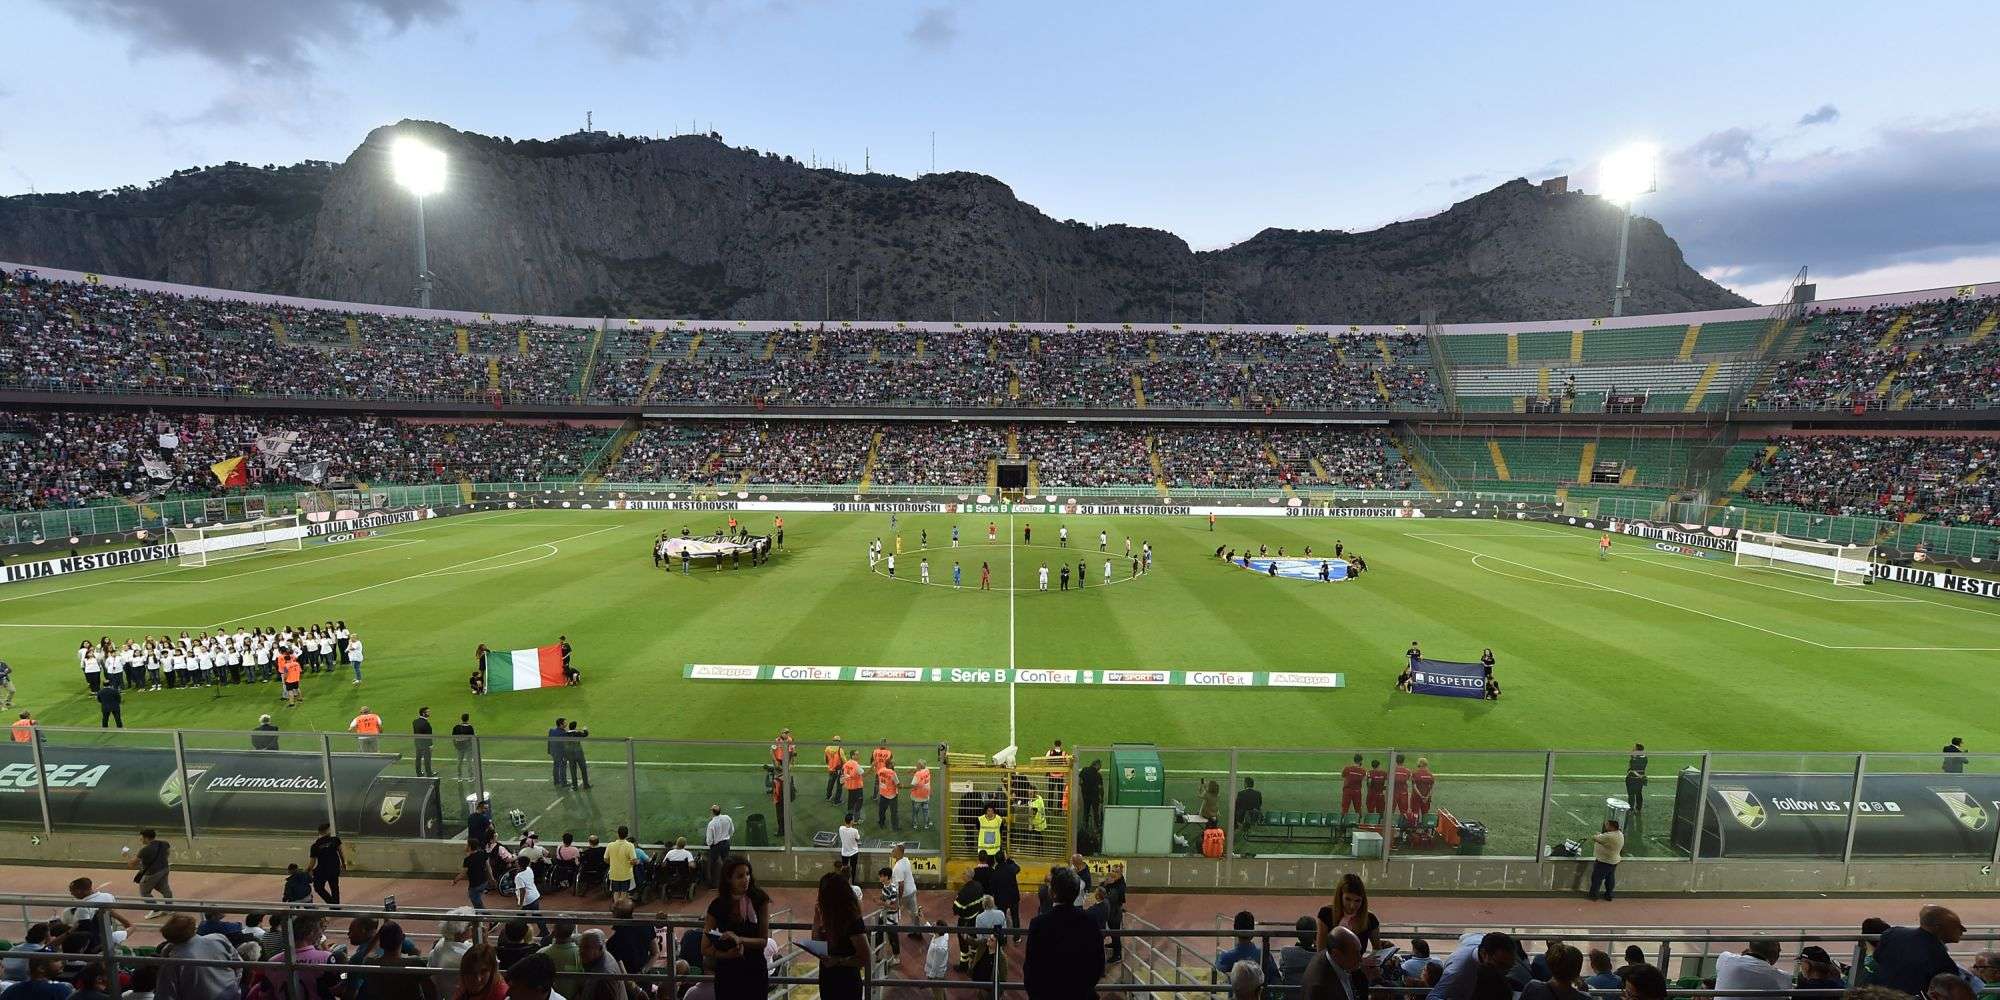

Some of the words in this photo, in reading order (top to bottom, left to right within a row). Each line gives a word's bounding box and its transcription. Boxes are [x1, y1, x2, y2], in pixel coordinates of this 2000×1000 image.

[631, 501, 643, 510] 30
[647, 501, 669, 510] ILIJA
[672, 501, 738, 510] NESTOROVSKI
[833, 503, 845, 512] 30
[849, 503, 870, 512] ILIJA
[874, 503, 940, 512] NESTOROVSKI
[976, 504, 999, 512] Serie
[1000, 504, 1008, 512] B
[1081, 506, 1094, 514] 30
[1098, 506, 1120, 514] ILIJA
[1123, 506, 1190, 514] NESTOROVSKI
[1286, 507, 1299, 516] 30
[1302, 508, 1325, 516] ILIJA
[1329, 508, 1396, 517] NESTOROVSKI
[307, 524, 321, 536] 30
[325, 522, 349, 533] ILIJA
[352, 512, 414, 529] NESTOROVSKI
[1628, 525, 1640, 536] 30
[1643, 527, 1663, 539] ILIJA
[1666, 530, 1737, 551] NESTOROVSKI
[6, 561, 54, 581] ILIJA
[60, 543, 179, 572] NESTOROVSKI
[1869, 563, 1890, 578] 30
[1896, 567, 1936, 587] ILIJA
[951, 668, 990, 682] Serie
[994, 669, 1006, 682] B
[1428, 675, 1484, 688] RISPETTO
[206, 774, 334, 790] palermocalcio.i
[1772, 797, 1818, 811] follow
[1821, 801, 1840, 811] us
[925, 861, 937, 870] 1A
